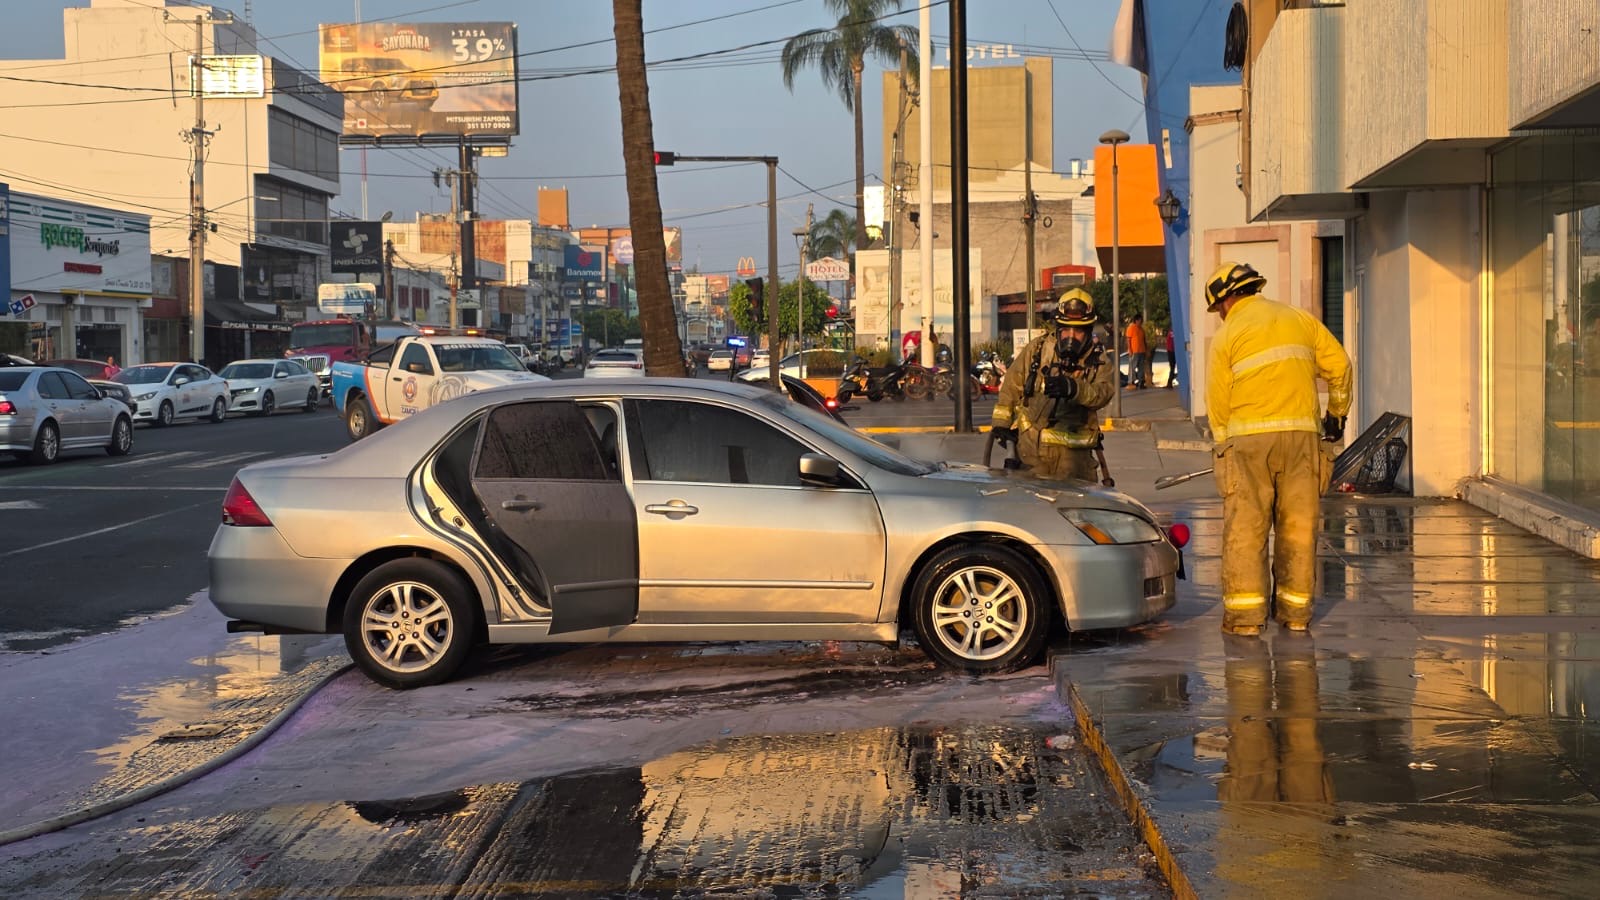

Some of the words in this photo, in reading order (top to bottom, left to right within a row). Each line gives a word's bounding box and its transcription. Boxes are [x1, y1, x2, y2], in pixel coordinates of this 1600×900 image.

[458, 29, 486, 37] TASA
[382, 34, 432, 51] SAYONARA
[451, 37, 506, 62] 3.9%
[445, 115, 482, 123] MITSUBISHI
[483, 115, 511, 123] ZAMORA
[566, 268, 602, 277] Banamex
[810, 264, 844, 275] HOTEL
